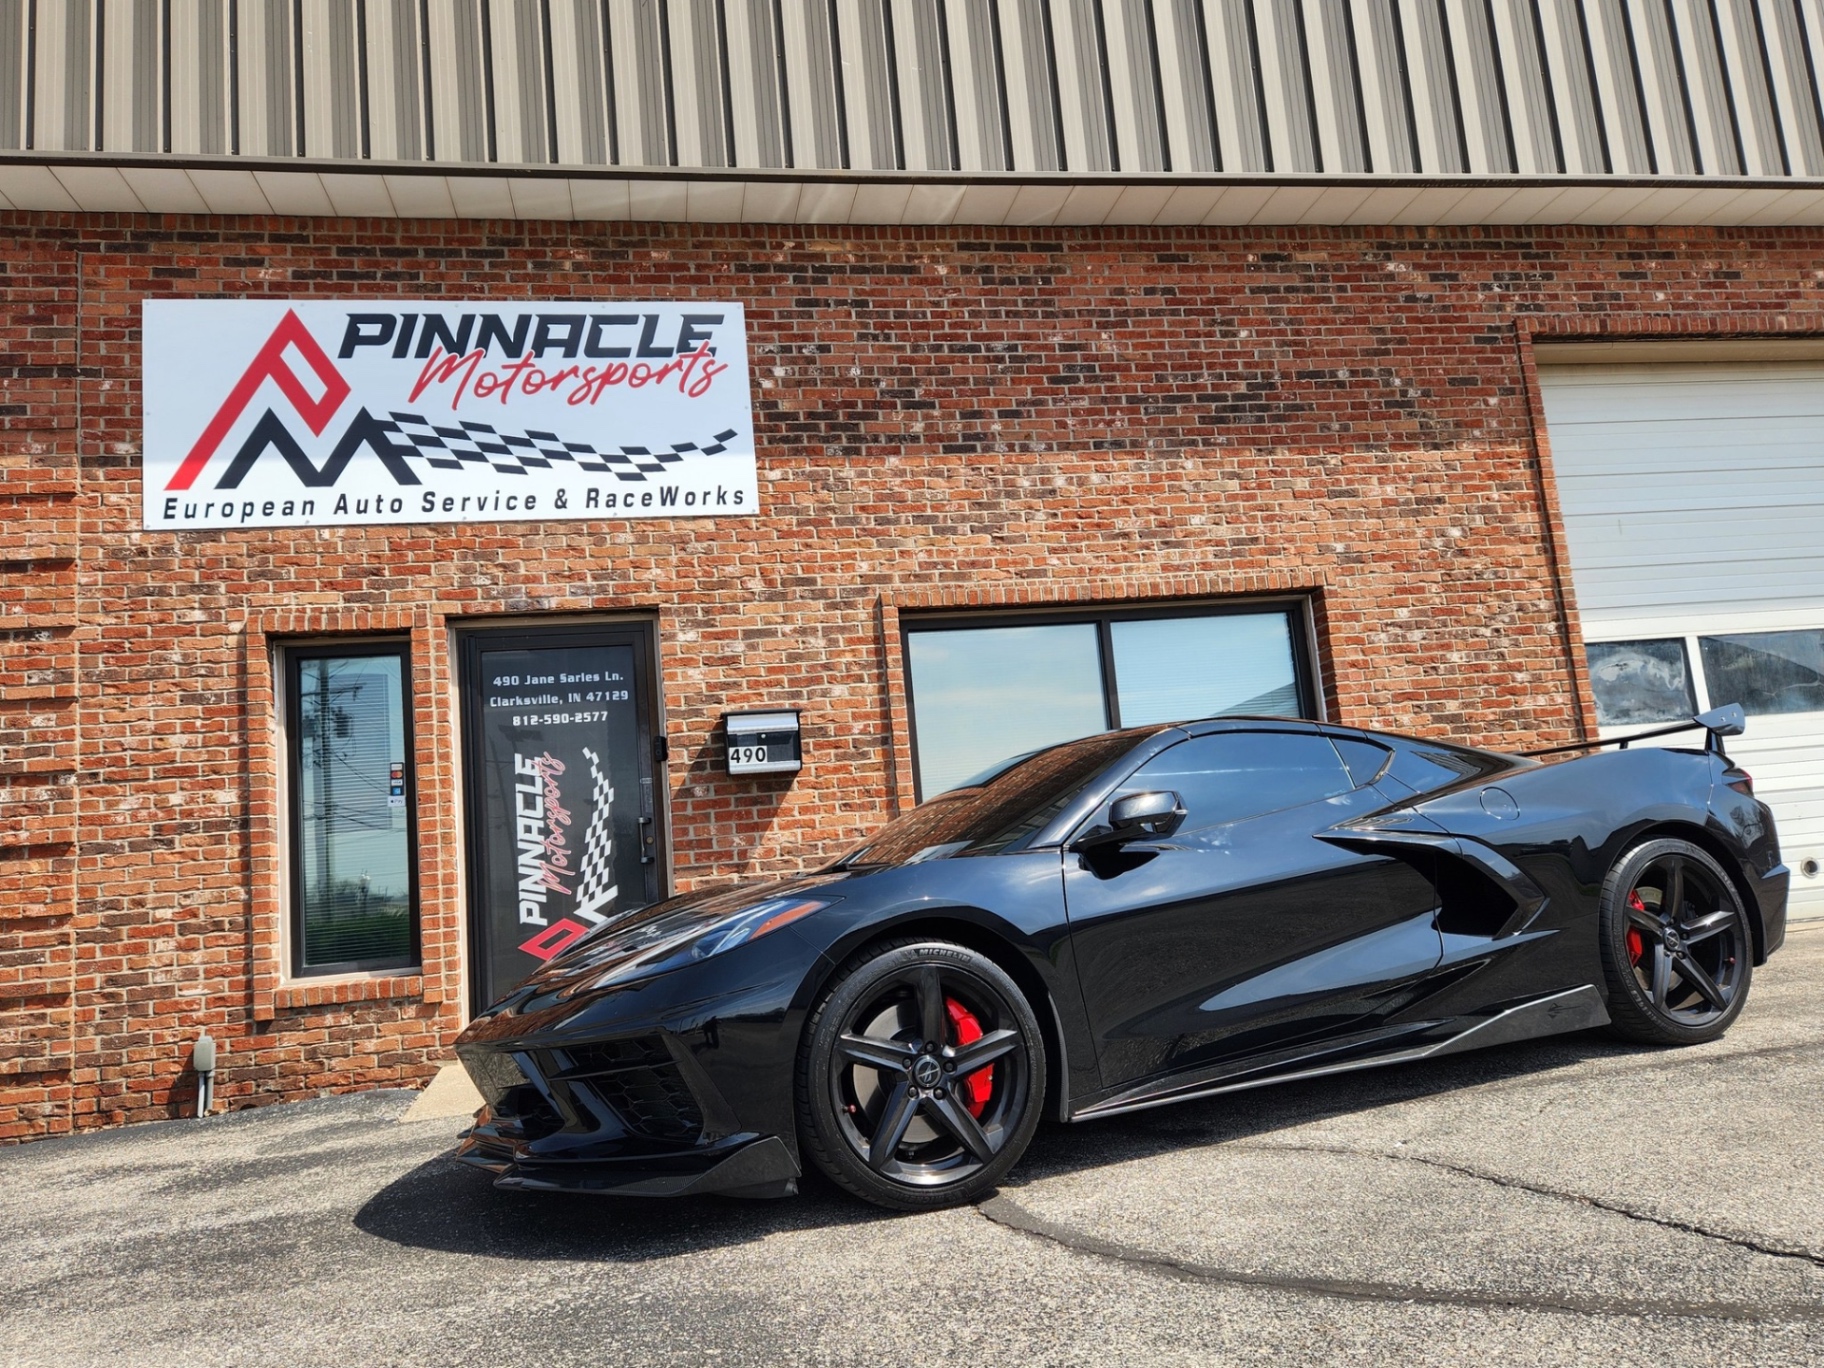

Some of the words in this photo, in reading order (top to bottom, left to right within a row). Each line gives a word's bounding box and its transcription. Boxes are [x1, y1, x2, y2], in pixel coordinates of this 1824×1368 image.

[337, 313, 725, 359] PINNACLE
[408, 339, 728, 410] Motorsports
[163, 496, 315, 523] European
[333, 493, 403, 515] Auto
[421, 490, 536, 512] Service
[554, 488, 568, 509] &
[585, 485, 744, 509] RaceWorks
[493, 675, 519, 686] 490
[524, 675, 555, 685] Jane
[559, 672, 600, 683] Sarles
[605, 671, 624, 681] Ln.
[490, 694, 563, 707] Clarksville,
[568, 692, 581, 703] IN
[586, 690, 629, 701] 47129
[512, 711, 608, 726] 812-590-2577
[730, 747, 766, 763] 490
[531, 751, 576, 895] Motorsports
[514, 753, 548, 926] PINNACLE
[919, 948, 971, 962] MICHELIN
